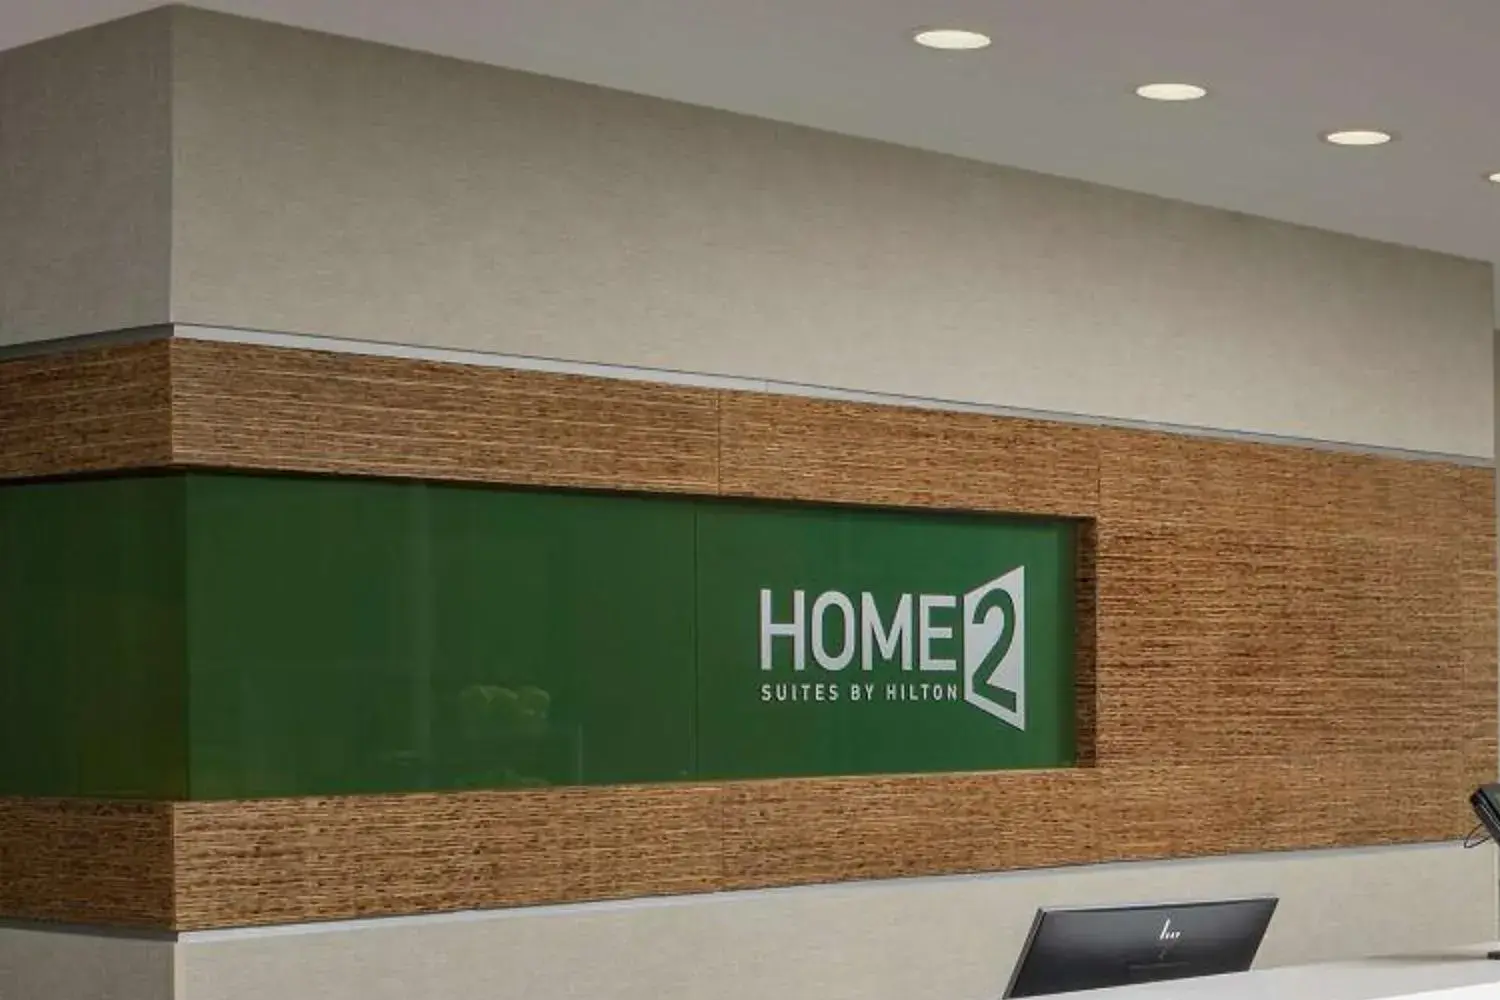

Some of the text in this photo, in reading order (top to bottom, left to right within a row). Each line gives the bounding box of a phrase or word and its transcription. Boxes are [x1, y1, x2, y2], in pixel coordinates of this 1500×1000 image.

[760, 683, 958, 701] SUITES BY HILTON
